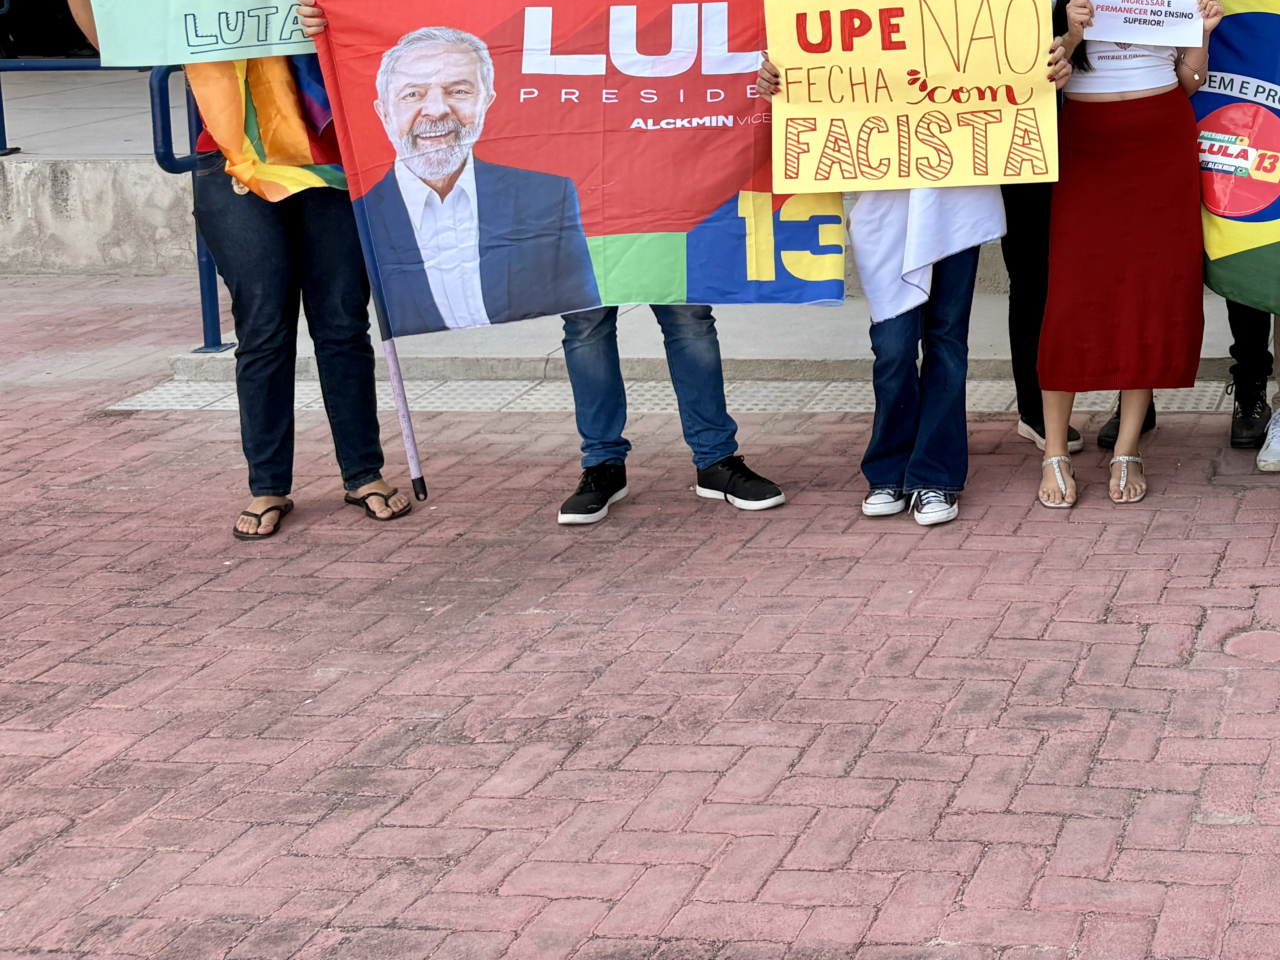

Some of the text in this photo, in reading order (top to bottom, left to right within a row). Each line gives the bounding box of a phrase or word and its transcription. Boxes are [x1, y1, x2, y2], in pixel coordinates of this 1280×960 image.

[1096, 4, 1194, 20] PERMANECER NO ENSINO
[1167, 0, 1172, 8] E
[184, 3, 308, 47] LUTA
[795, 6, 907, 54] UPE
[1122, 16, 1165, 27] SUPERIOR!
[521, 1, 768, 77] LUL
[519, 84, 760, 103] PRESIDE
[785, 65, 1034, 106] FECHA com
[1238, 80, 1251, 95] E
[629, 115, 734, 130] ALCKMIN
[784, 108, 1049, 182] FACISTA
[1200, 130, 1237, 142] PRESIDENTE
[1198, 141, 1249, 161] LULA
[1254, 152, 1280, 174] 13
[738, 190, 845, 281] 13
